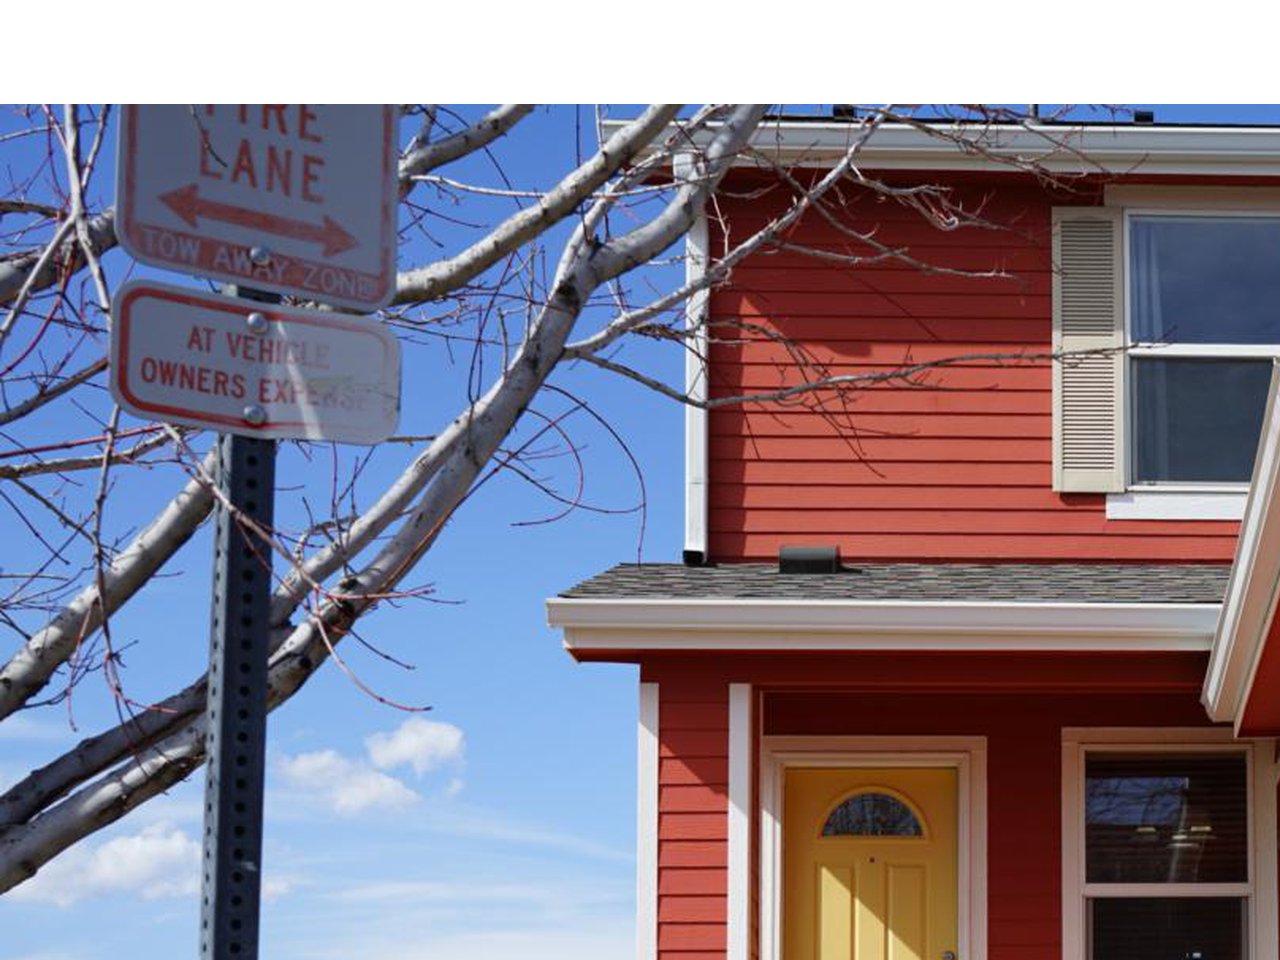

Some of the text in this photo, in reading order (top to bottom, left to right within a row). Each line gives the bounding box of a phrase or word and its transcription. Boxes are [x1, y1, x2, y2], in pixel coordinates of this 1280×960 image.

[206, 104, 323, 143] RE
[199, 129, 326, 205] LANE
[143, 228, 377, 300] TOW AWAY ZONE
[187, 325, 330, 369] AT VEHICLE
[140, 356, 246, 399] OWNERS
